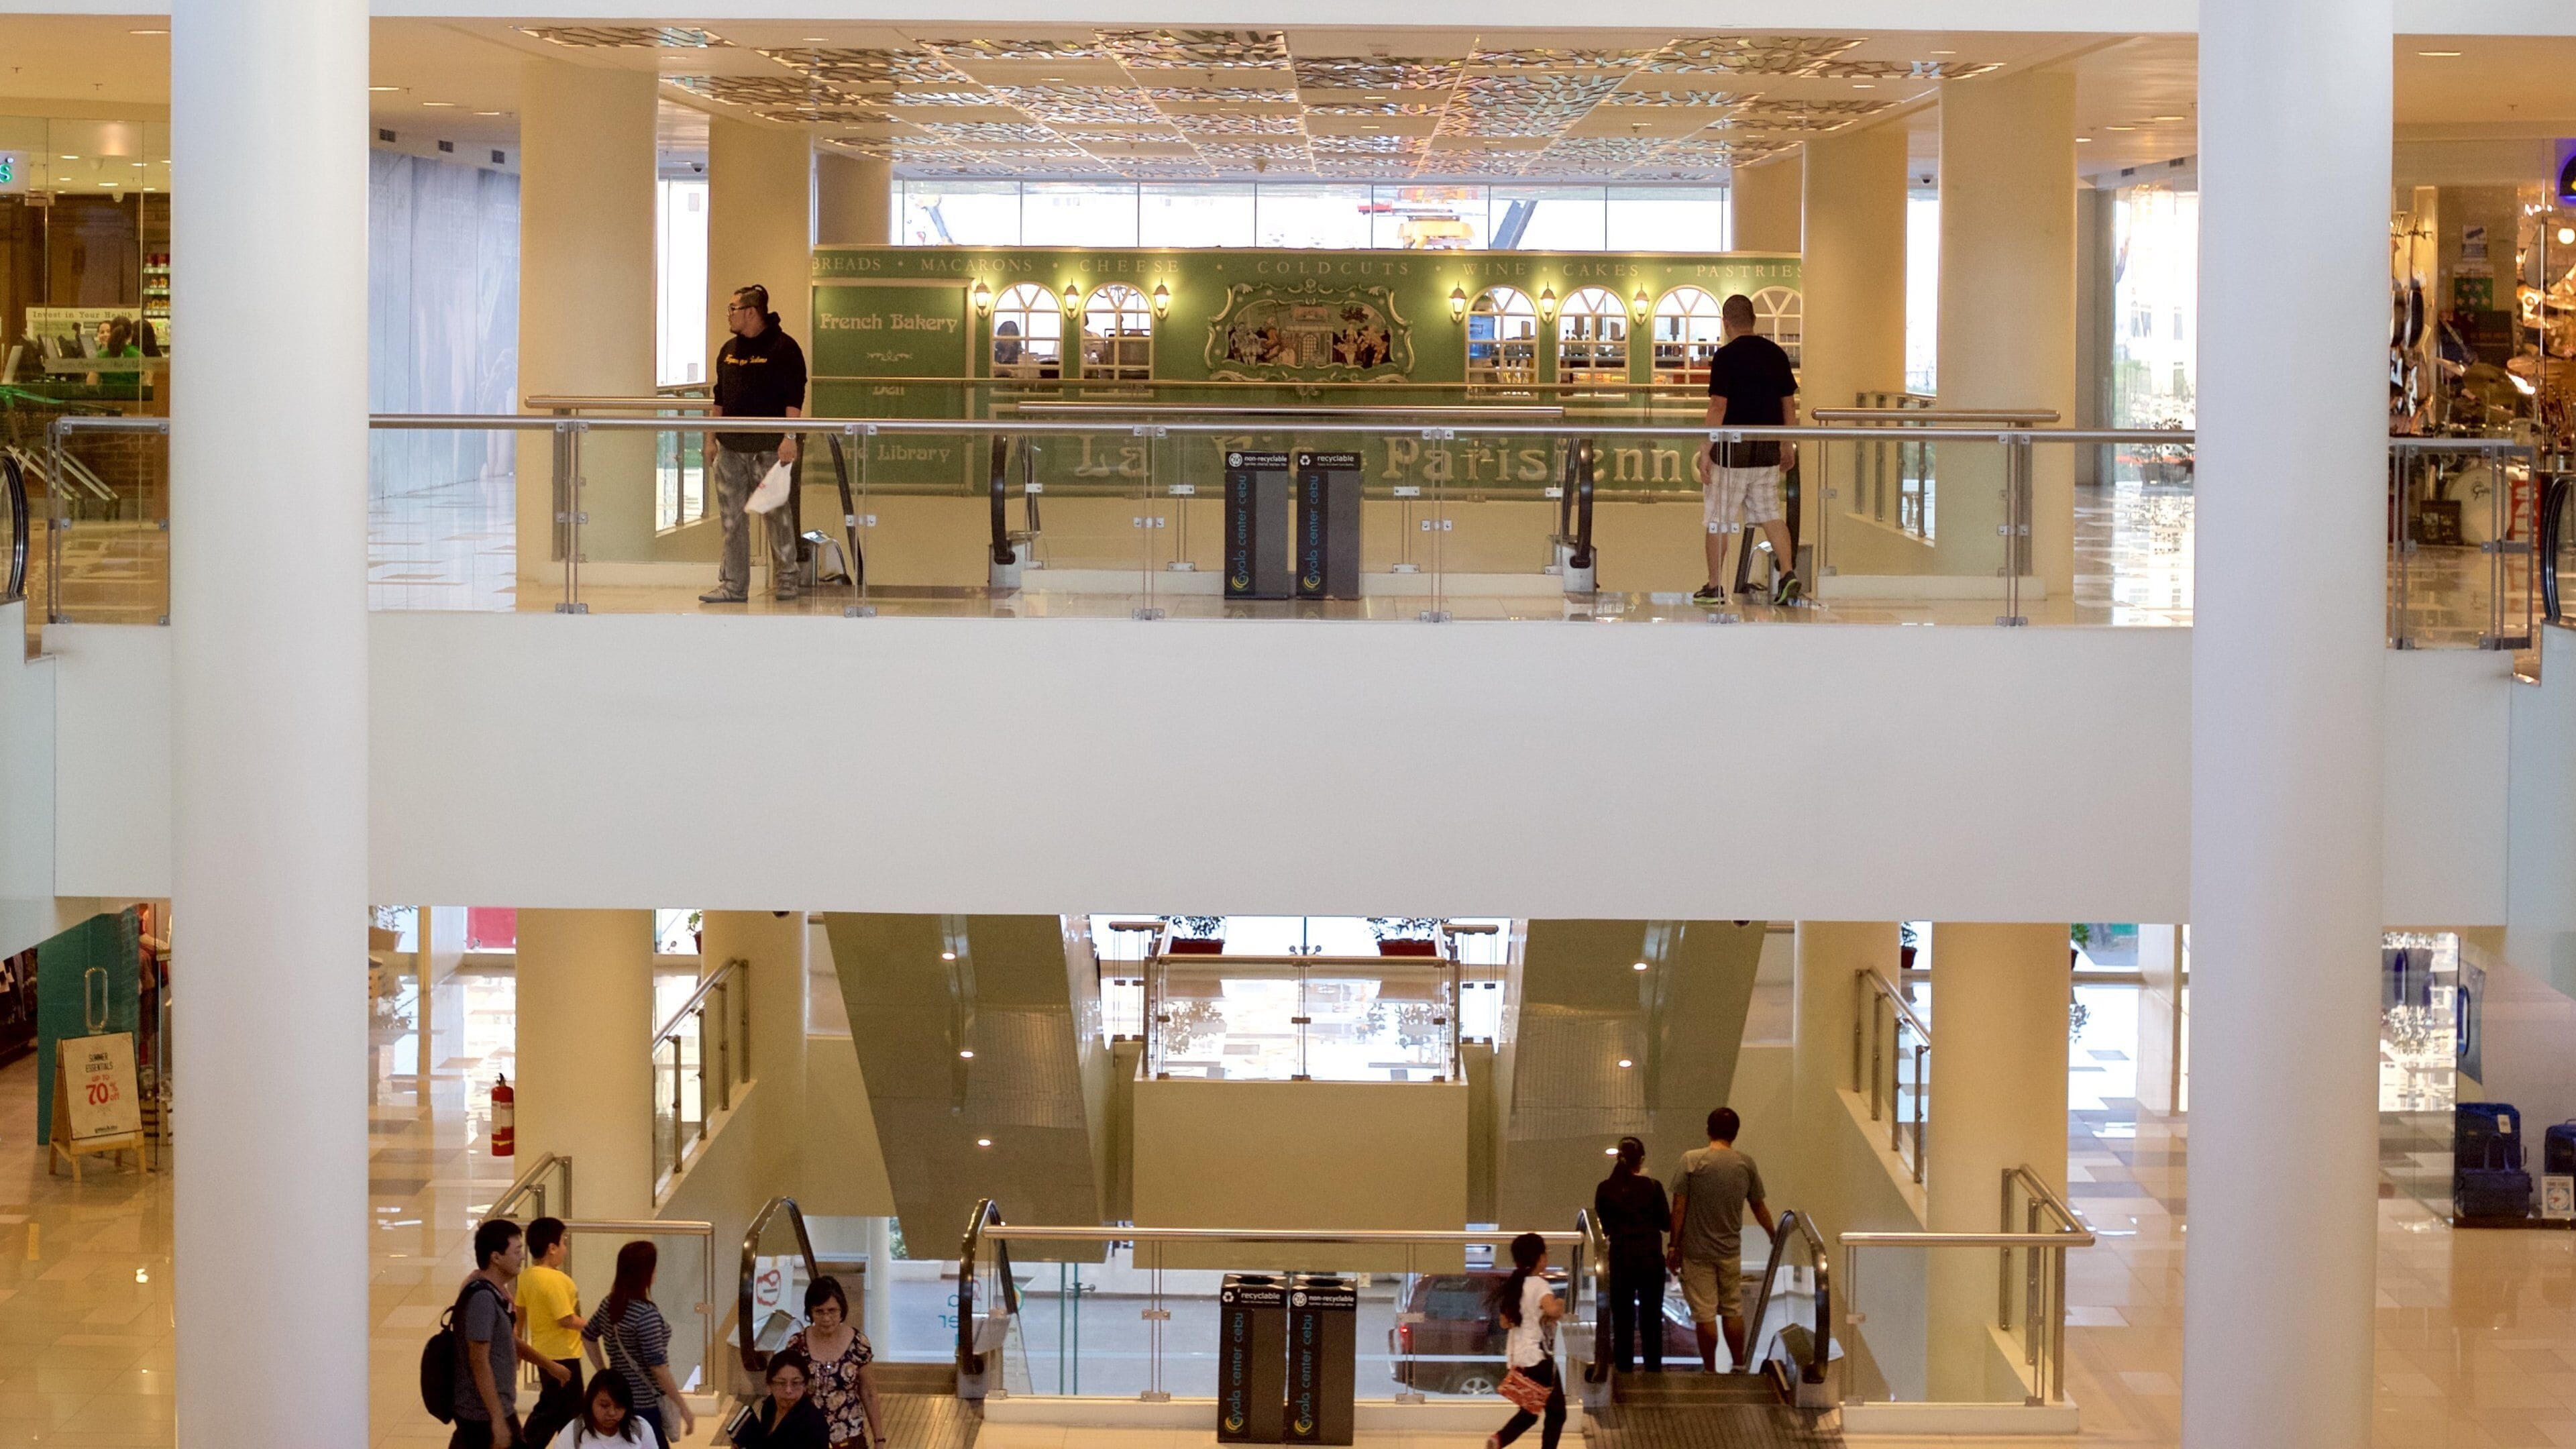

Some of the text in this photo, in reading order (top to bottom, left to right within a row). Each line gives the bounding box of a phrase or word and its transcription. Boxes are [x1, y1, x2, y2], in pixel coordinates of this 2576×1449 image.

[812, 258, 880, 270] BREADS
[921, 258, 1032, 272] MACARONS
[1079, 260, 1179, 272] CHEESE
[1257, 261, 1407, 275] COLDCUTS
[1463, 263, 1525, 276] WINE
[1562, 264, 1638, 276] CAKES
[820, 313, 958, 333] French Bakery
[877, 444, 951, 463] Library
[1074, 436, 1149, 477] La
[1244, 455, 1287, 463] non-recyclable
[1318, 454, 1354, 463] recyclable
[1233, 476, 1248, 583] ayala center cebu
[1305, 476, 1320, 583] ayala center cebu
[86, 1061, 113, 1073] ESSENTIALS
[1241, 1292, 1281, 1300] recyclable
[1309, 1295, 1354, 1303] non-recyclable
[1227, 1313, 1243, 1424] ayala center cebu
[1295, 1315, 1313, 1428] ayala center cebu
